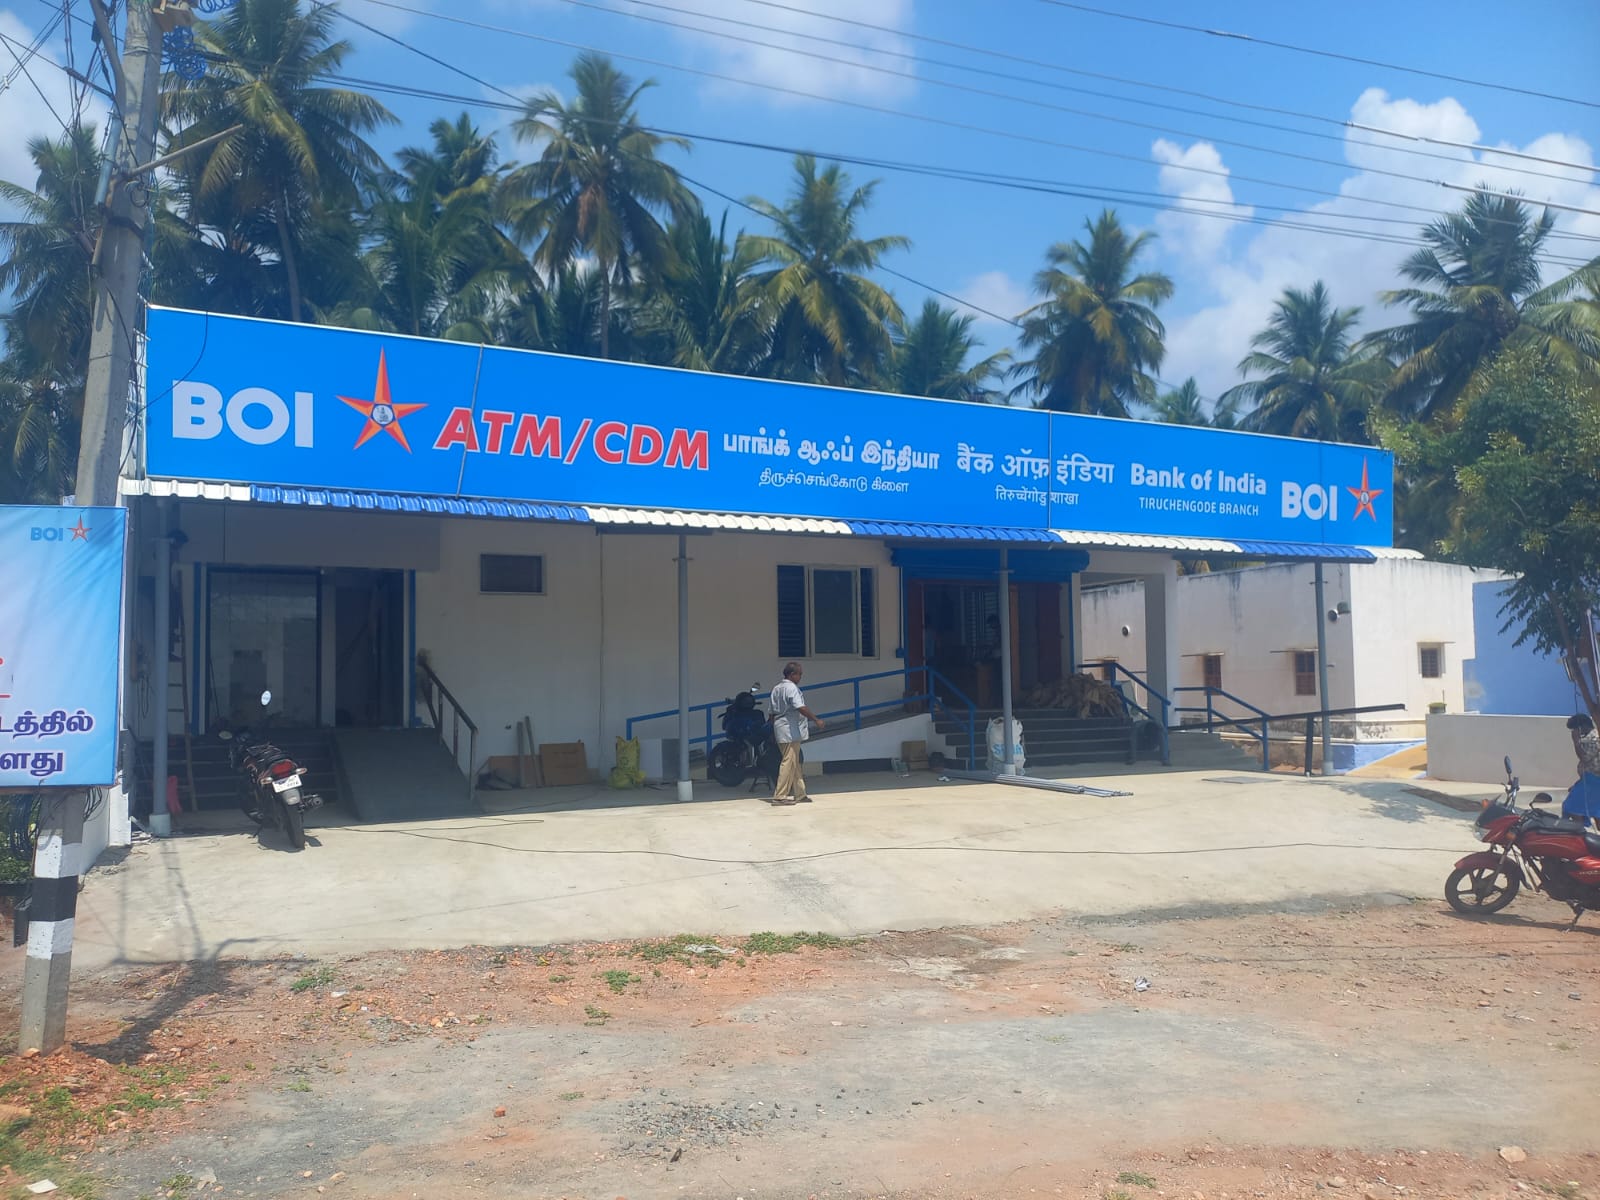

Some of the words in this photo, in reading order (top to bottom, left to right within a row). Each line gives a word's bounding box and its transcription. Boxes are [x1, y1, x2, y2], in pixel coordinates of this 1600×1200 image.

[172, 379, 314, 449] BOI
[432, 406, 710, 471] ATM/CDM
[723, 426, 791, 457] பாங்க்
[797, 435, 854, 465] ஆஃப்
[861, 439, 940, 473] இந்தியா
[758, 467, 868, 492] திருச்செங்கோடு
[871, 476, 909, 493] கிளை
[956, 442, 994, 474] बैंक
[1056, 452, 1115, 485] इंडिया
[1130, 462, 1185, 489] Bank
[1190, 469, 1213, 491] of
[1218, 470, 1267, 496] India
[1139, 496, 1217, 514] TIRUCHENGODE
[1219, 502, 1259, 517] BRANCH
[1281, 481, 1338, 522] BOI
[30, 526, 64, 542] BOI
